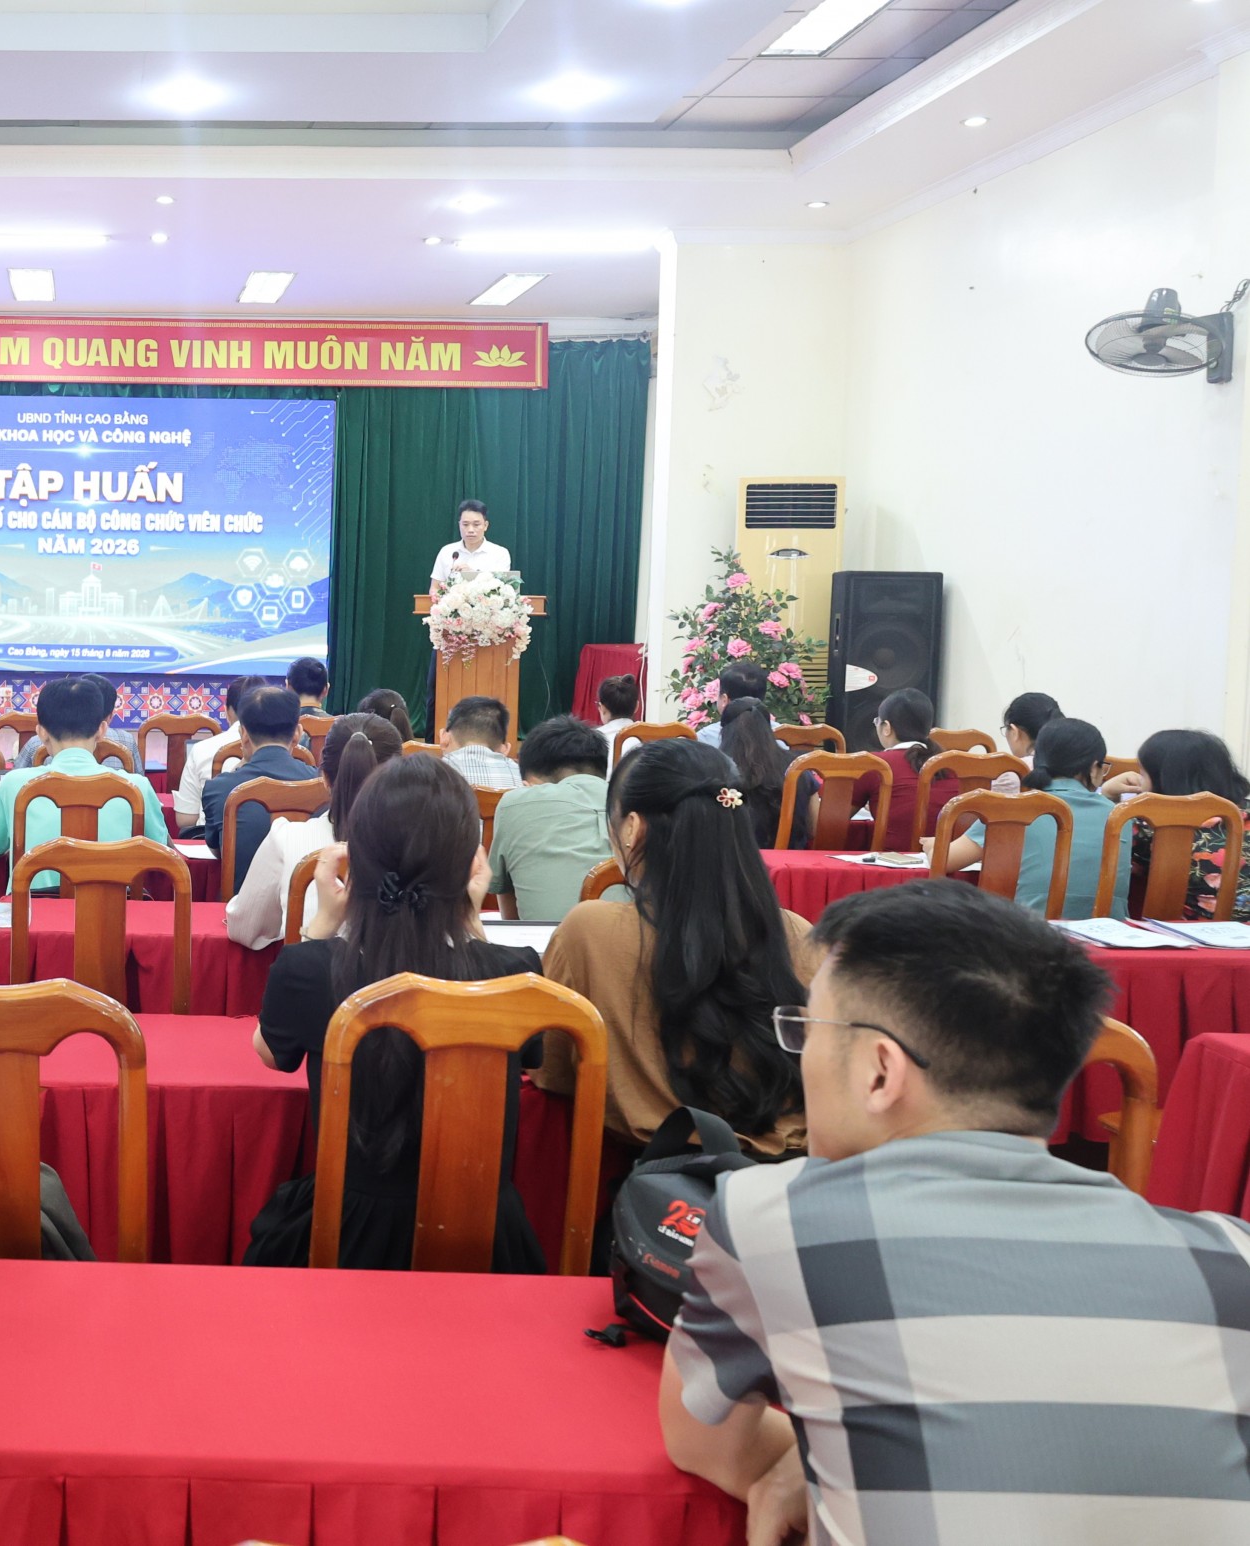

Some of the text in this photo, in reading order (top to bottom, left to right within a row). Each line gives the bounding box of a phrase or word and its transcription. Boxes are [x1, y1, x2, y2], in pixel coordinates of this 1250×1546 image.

[42, 337, 158, 369] QUANG
[170, 339, 251, 368] VINH
[264, 335, 368, 370] MUÔN
[380, 336, 461, 371] NĂM
[17, 410, 148, 425] UBND TỈNH CAO BẰNG
[42, 429, 74, 445] HỌC
[78, 427, 98, 443] VÀ
[102, 427, 145, 443] CÔNG
[149, 428, 191, 447] NGHỆ
[74, 462, 183, 503] HUẤN
[7, 511, 38, 530] CHO
[41, 508, 72, 530] CÁN
[76, 509, 96, 533] BỘ
[101, 509, 141, 531] CÔNG
[145, 510, 185, 532] CHỨC
[188, 511, 221, 533] VIÊN
[224, 511, 263, 533] CHỨC
[37, 534, 140, 555] NĂM 2026
[7, 647, 24, 656] Cao
[50, 648, 70, 658] ngày
[71, 648, 81, 657] 15
[81, 648, 105, 659] tháng
[112, 649, 130, 658] năm
[130, 649, 151, 658] 2026
